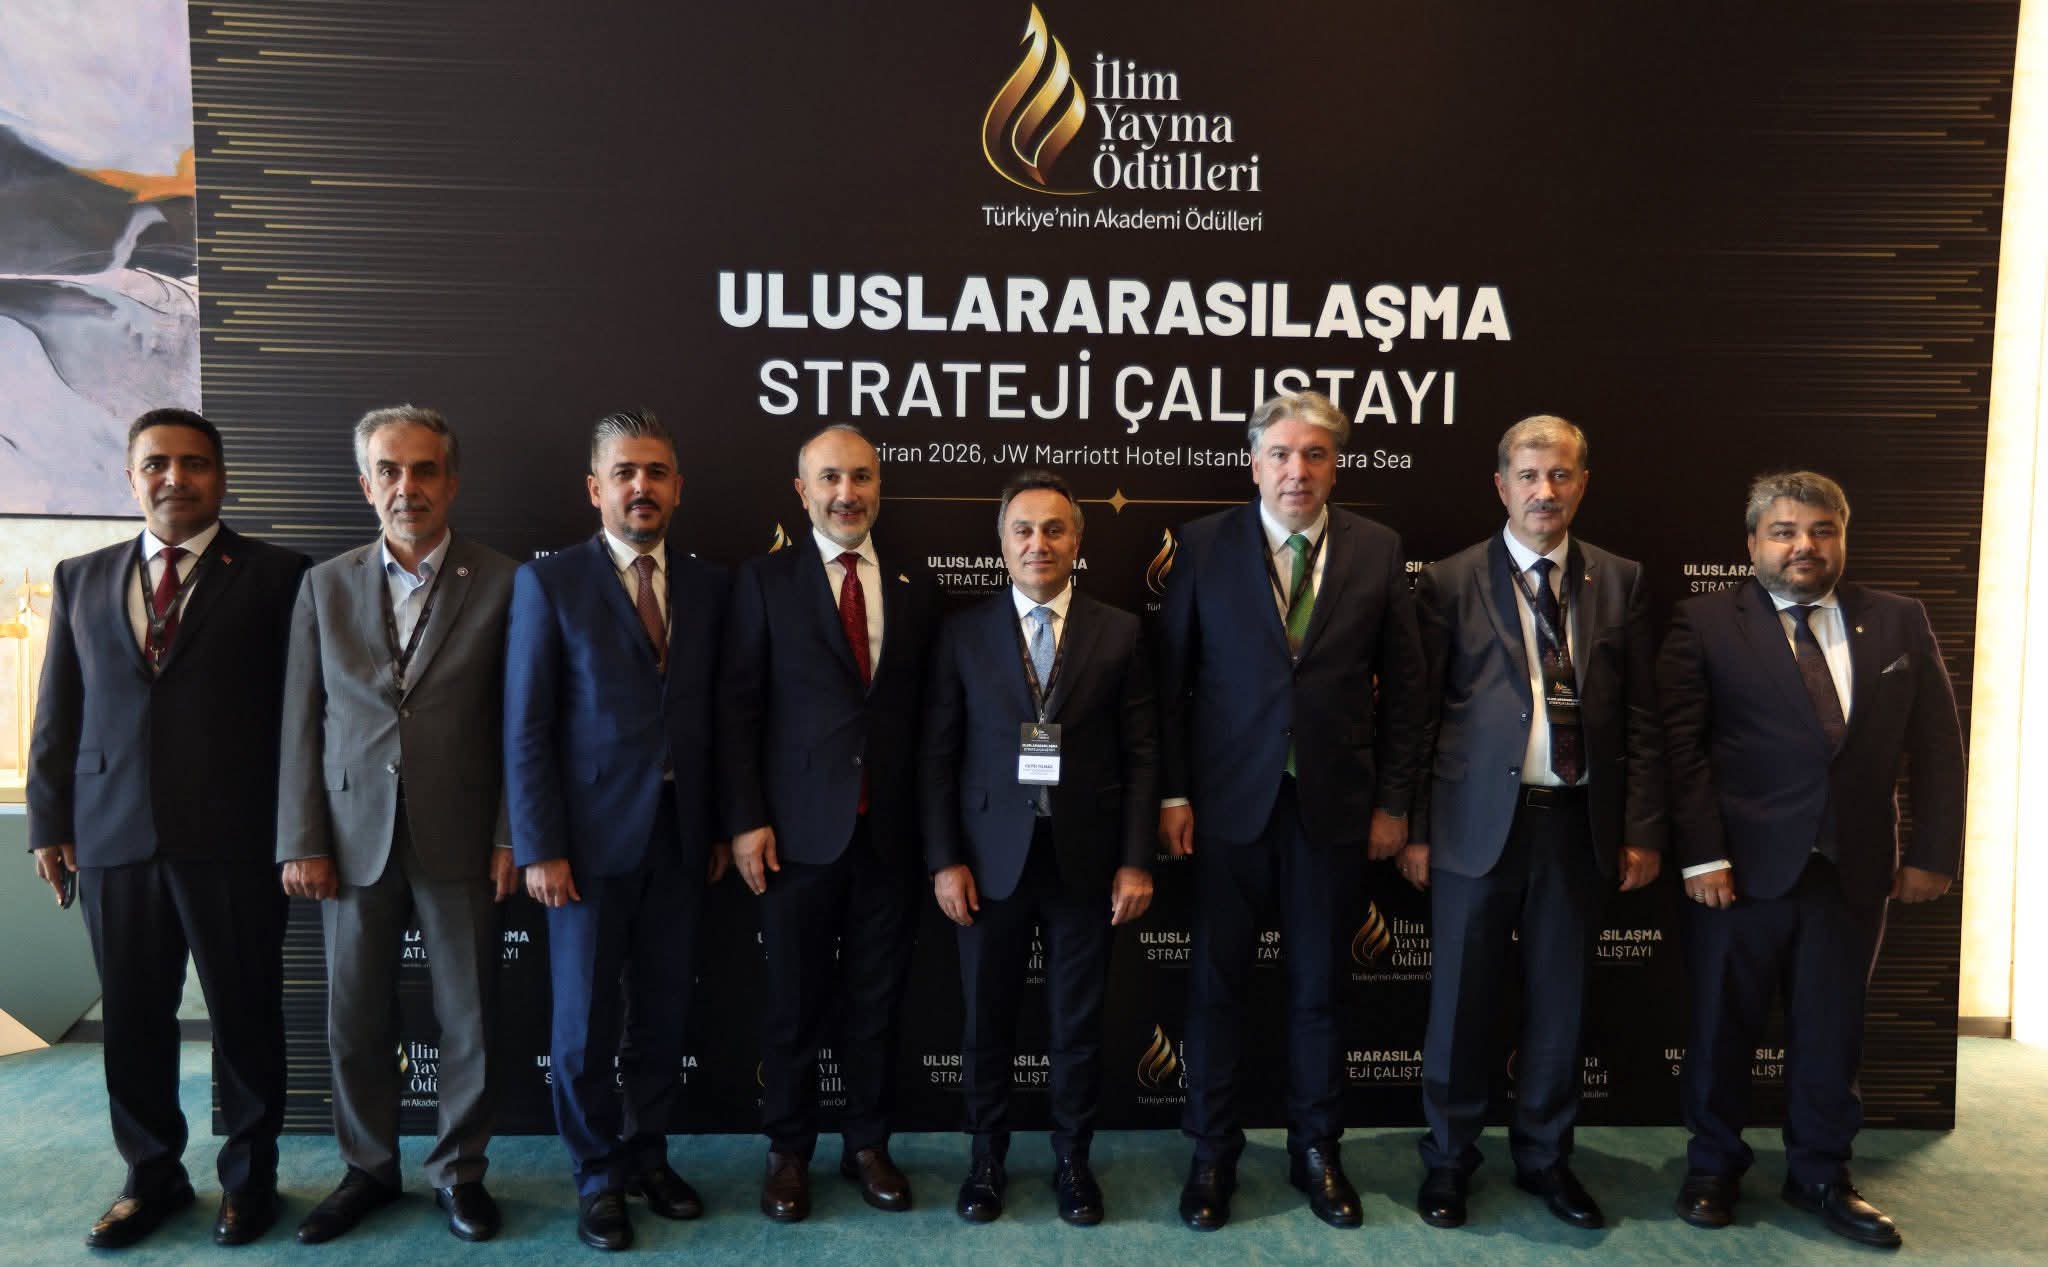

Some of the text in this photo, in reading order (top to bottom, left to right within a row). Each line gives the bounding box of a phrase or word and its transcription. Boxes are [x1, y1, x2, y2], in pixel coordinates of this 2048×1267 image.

[1093, 53, 1180, 101] İlim
[1095, 103, 1235, 149] Yayma
[1093, 145, 1261, 192] Ödülleri
[1094, 208, 1181, 230] Akademi
[1185, 208, 1263, 232] Ödülleri
[719, 272, 1512, 352] ULUSLARARASILAŞMA
[759, 350, 1091, 420] STRATEJİ
[928, 442, 986, 465] 2026,
[993, 444, 1028, 464] JW
[1035, 445, 1119, 465] Marriott
[1126, 446, 1181, 466] Hotel
[1188, 448, 1252, 467] Istanb
[1373, 449, 1411, 469] Sea
[936, 571, 1004, 586] STRATEJİ
[1391, 949, 1432, 967] Ödüll
